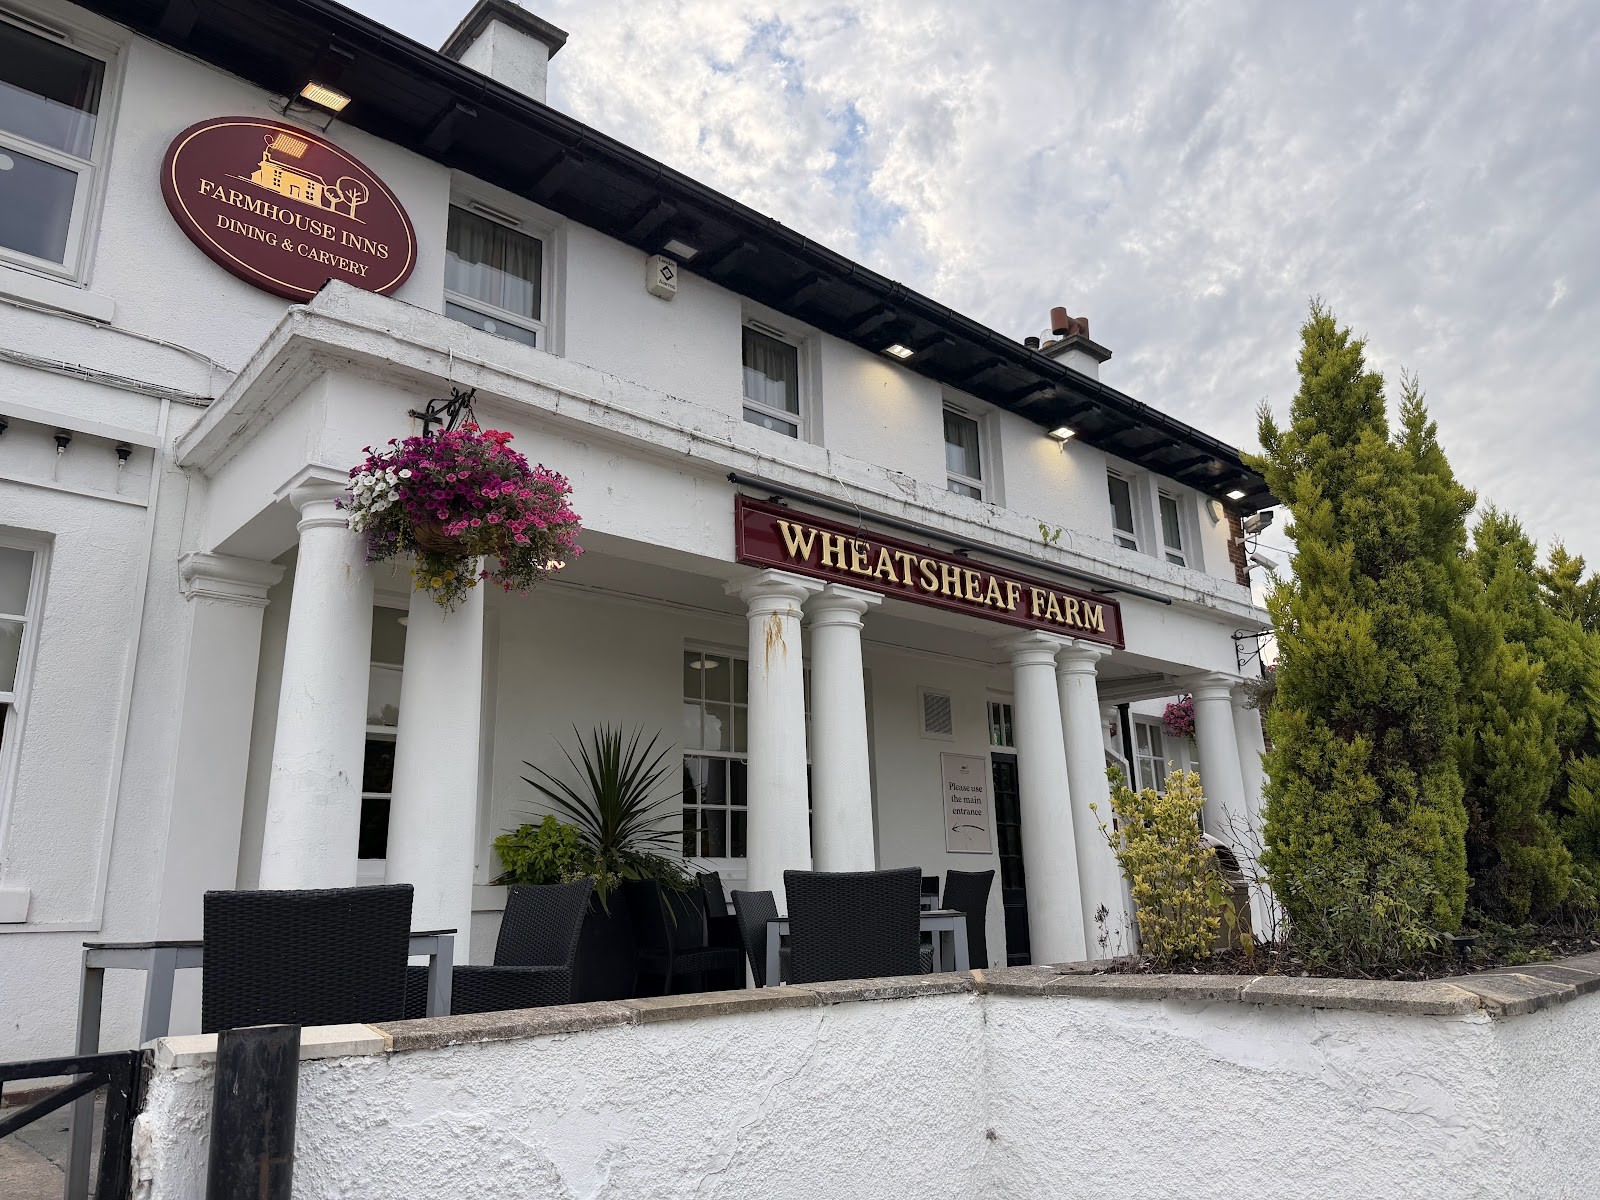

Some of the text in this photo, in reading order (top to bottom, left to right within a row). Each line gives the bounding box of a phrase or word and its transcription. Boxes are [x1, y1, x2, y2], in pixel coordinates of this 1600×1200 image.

[198, 178, 389, 259] FARMHOUSE INNS
[216, 215, 369, 277] DINING & CARVERY
[776, 519, 1106, 633] WHEATSHEAF FARM
[949, 782, 970, 792] Please
[951, 794, 962, 803] the
[952, 808, 982, 816] entrance
